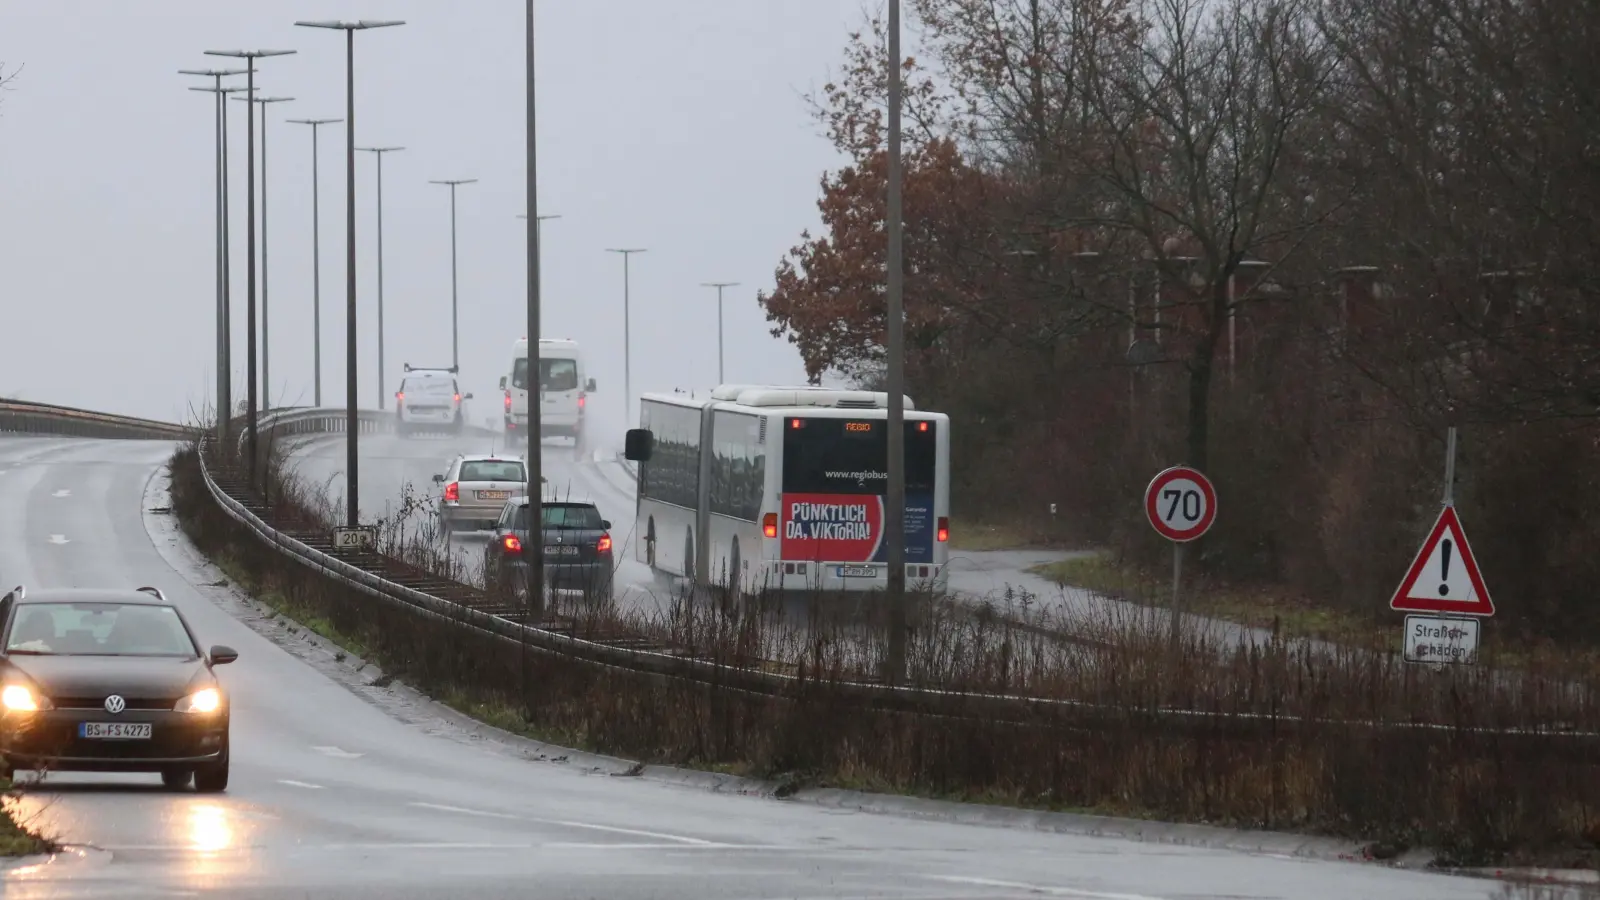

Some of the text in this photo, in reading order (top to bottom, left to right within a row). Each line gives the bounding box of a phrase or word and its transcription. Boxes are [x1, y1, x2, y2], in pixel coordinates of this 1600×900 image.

[845, 422, 871, 432] REGIO
[791, 502, 867, 522] PÜNKTLICH
[1163, 489, 1201, 522] 70
[786, 520, 809, 541] DA,
[343, 533, 358, 545] 20
[1415, 642, 1466, 657] chäden
[86, 723, 151, 738] BS FS 4273
